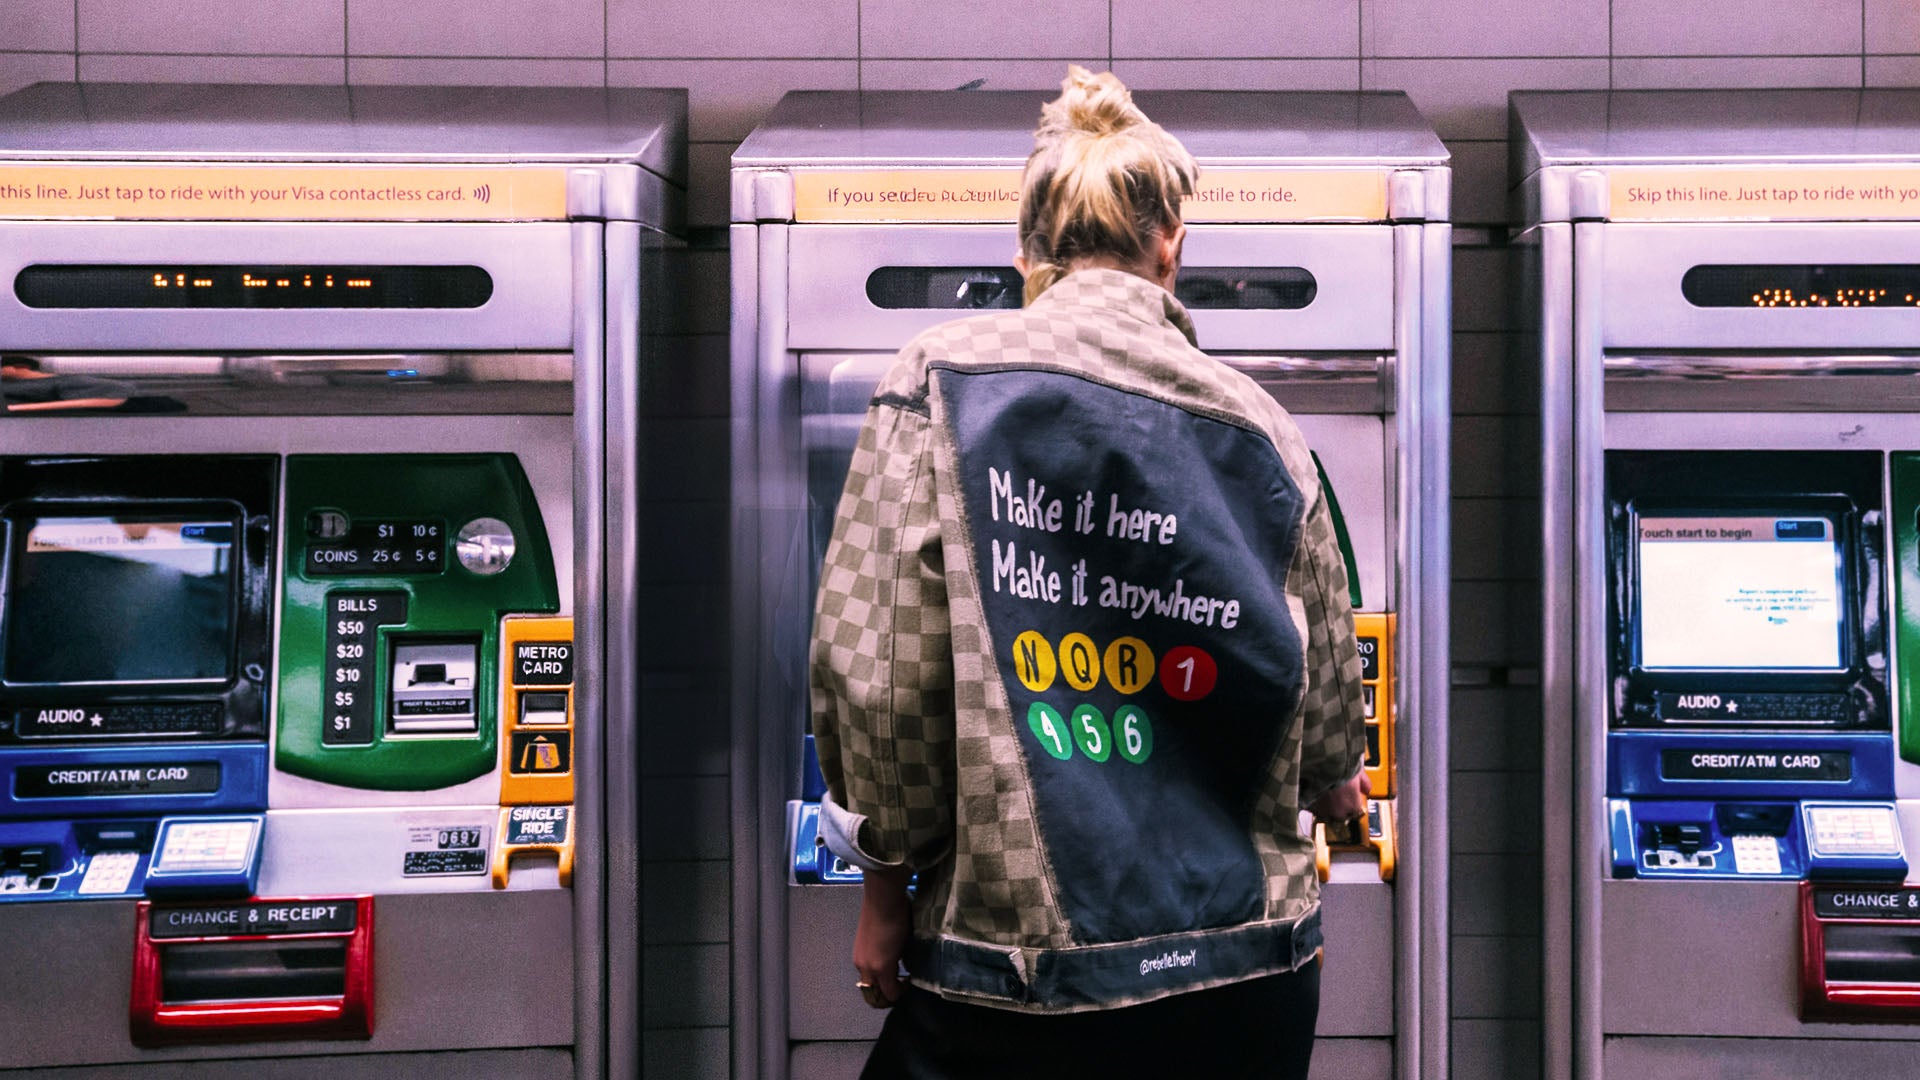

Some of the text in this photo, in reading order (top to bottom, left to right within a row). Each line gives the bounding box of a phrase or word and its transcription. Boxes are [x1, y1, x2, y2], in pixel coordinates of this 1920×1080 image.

[1, 184, 466, 203] this line. Just tap to ride with your Visa contactless card.
[828, 187, 840, 203] If
[843, 190, 874, 207] you
[1240, 188, 1257, 202] to
[1261, 187, 1297, 202] ride.
[1628, 185, 1920, 205] Skip this line. Just tap to ride with yo
[989, 467, 1177, 545] Make it here
[378, 524, 394, 537] $1
[1778, 521, 1798, 530] Start
[1676, 528, 1703, 538] start
[1705, 528, 1718, 538] to
[1720, 528, 1752, 540] begin
[314, 551, 358, 563] COINS
[992, 539, 1241, 629] Make it anywhere
[338, 599, 378, 612] BILLS
[337, 621, 364, 636] $50
[336, 644, 364, 659] $20
[518, 646, 568, 660] METRO
[522, 661, 563, 675] CARD
[1021, 639, 1195, 693] N Q R 1
[336, 668, 361, 683] $10
[335, 691, 354, 707] $5
[1677, 695, 1722, 709] AUDIO
[37, 708, 85, 724] AUDIO
[334, 715, 351, 731] $1
[1081, 714, 1102, 754] 5
[1124, 713, 1142, 756] 6
[1691, 754, 1822, 769] CREDIT/ATM CARD
[48, 767, 189, 784] CREDIT/ATM CARD
[512, 807, 565, 821] SINGLE
[520, 821, 555, 835] RIDE
[440, 831, 479, 845] 0697
[1833, 893, 1919, 908] CHANGE &
[169, 906, 338, 926] CHANGE & RECEIPT
